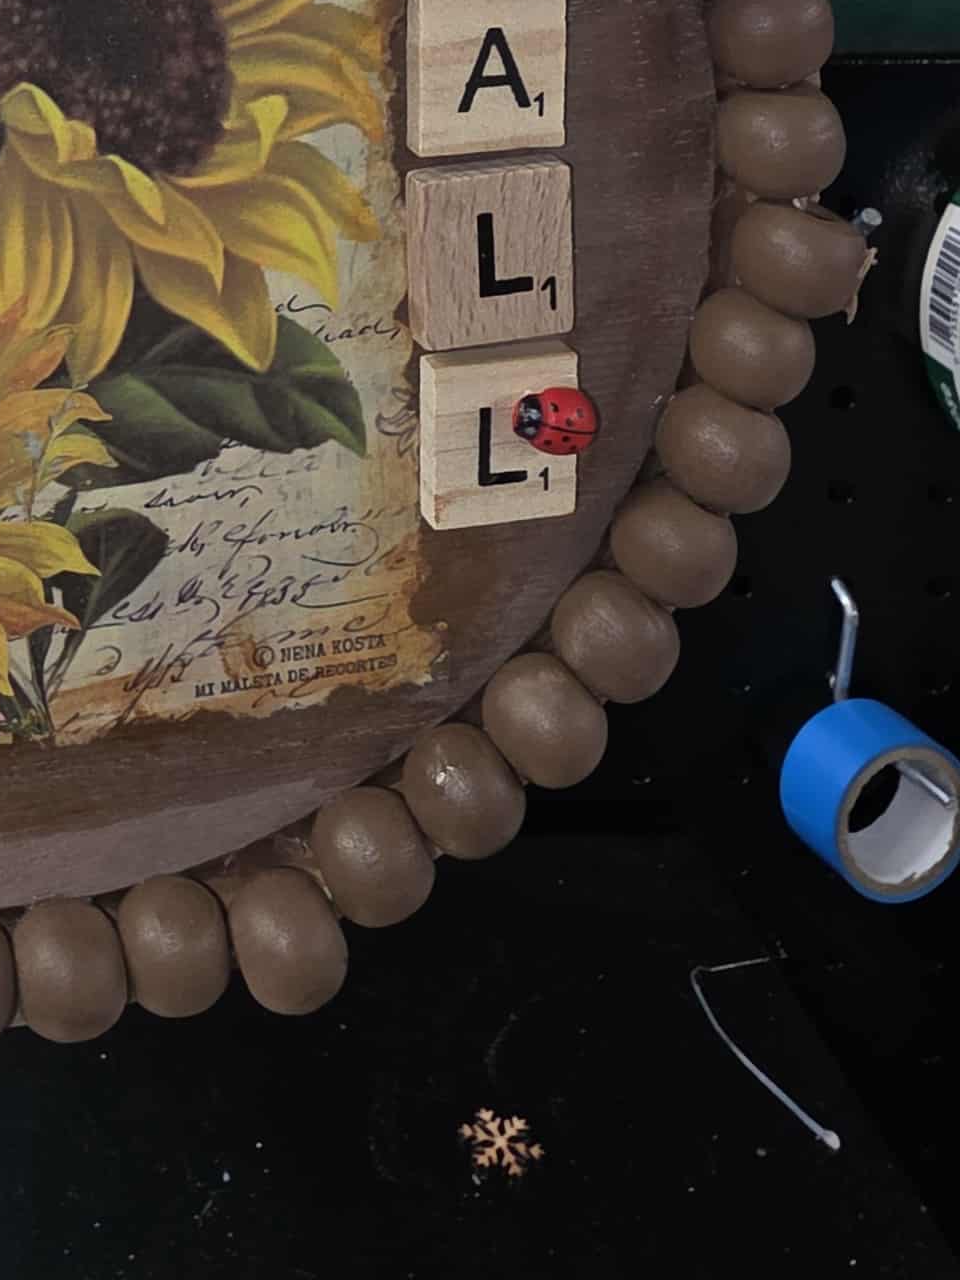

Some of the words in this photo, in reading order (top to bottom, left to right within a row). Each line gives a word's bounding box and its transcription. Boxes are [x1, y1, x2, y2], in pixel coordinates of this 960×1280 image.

[533, 92, 545, 117] 1
[540, 276, 557, 311] 1
[538, 466, 550, 491] 1
[279, 641, 326, 663] NENA
[332, 633, 386, 655] KOSTA
[194, 683, 214, 698] MI
[287, 668, 307, 683] DE
